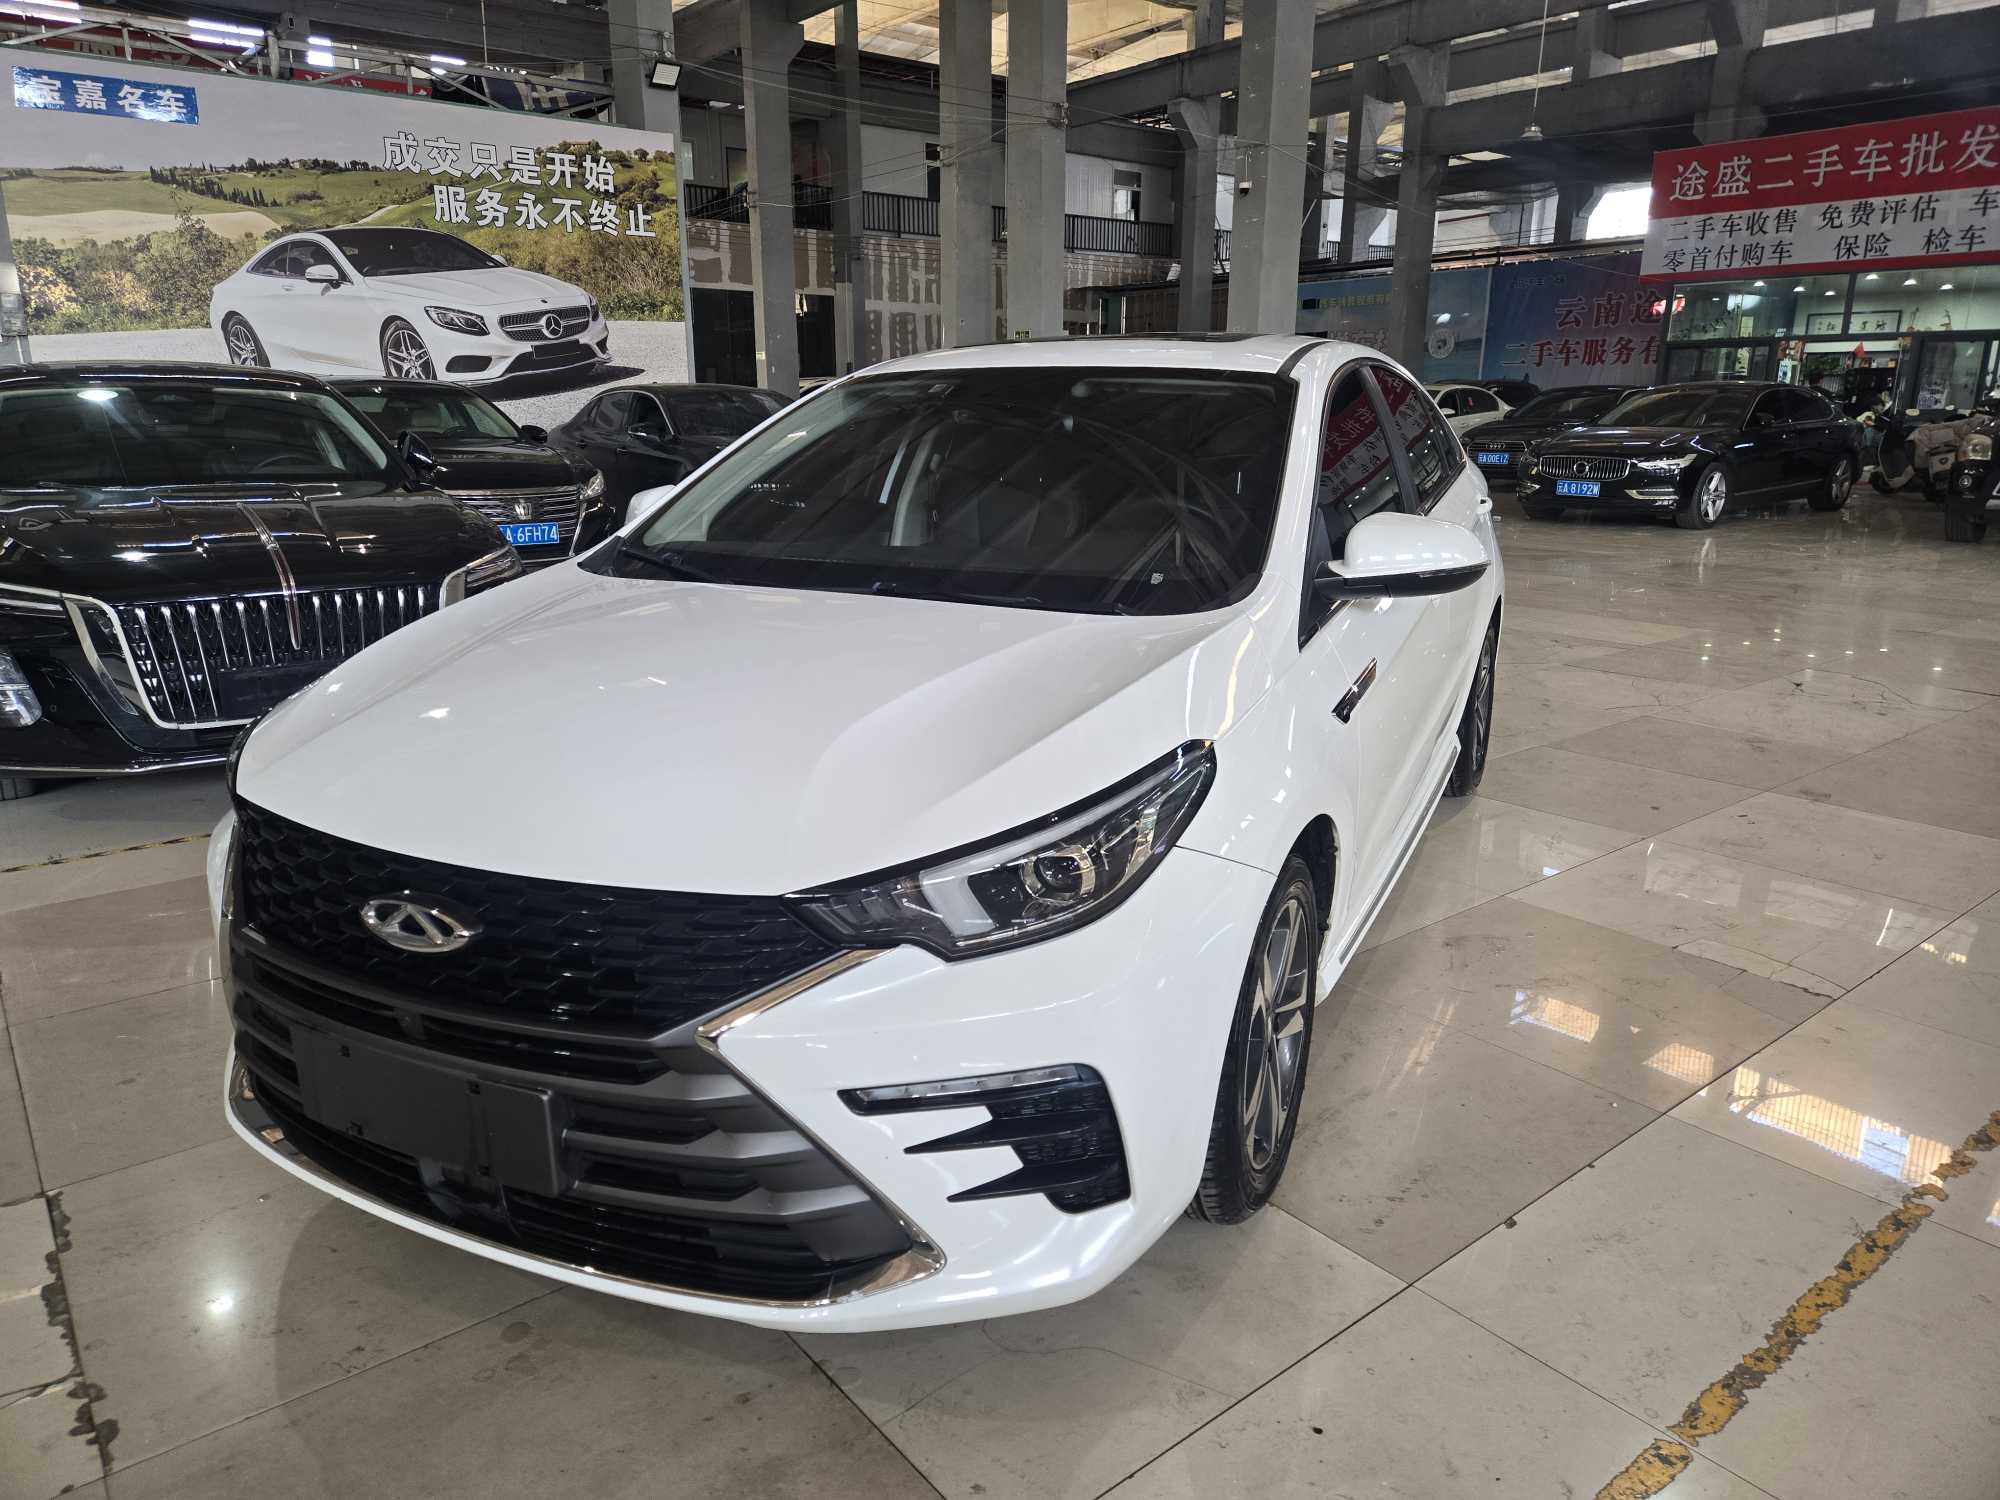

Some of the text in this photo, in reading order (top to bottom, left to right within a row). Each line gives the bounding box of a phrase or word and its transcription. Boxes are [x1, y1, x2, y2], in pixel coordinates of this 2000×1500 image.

[383, 131, 616, 193] 成交只是开始
[1669, 124, 2000, 201] 途盛二手车批发
[433, 185, 656, 237] 服务永不终止
[1667, 208, 1797, 242] 二手车收售
[1818, 194, 1940, 231] 免费评估
[1663, 225, 1986, 272] 零首付购车 保险 检车
